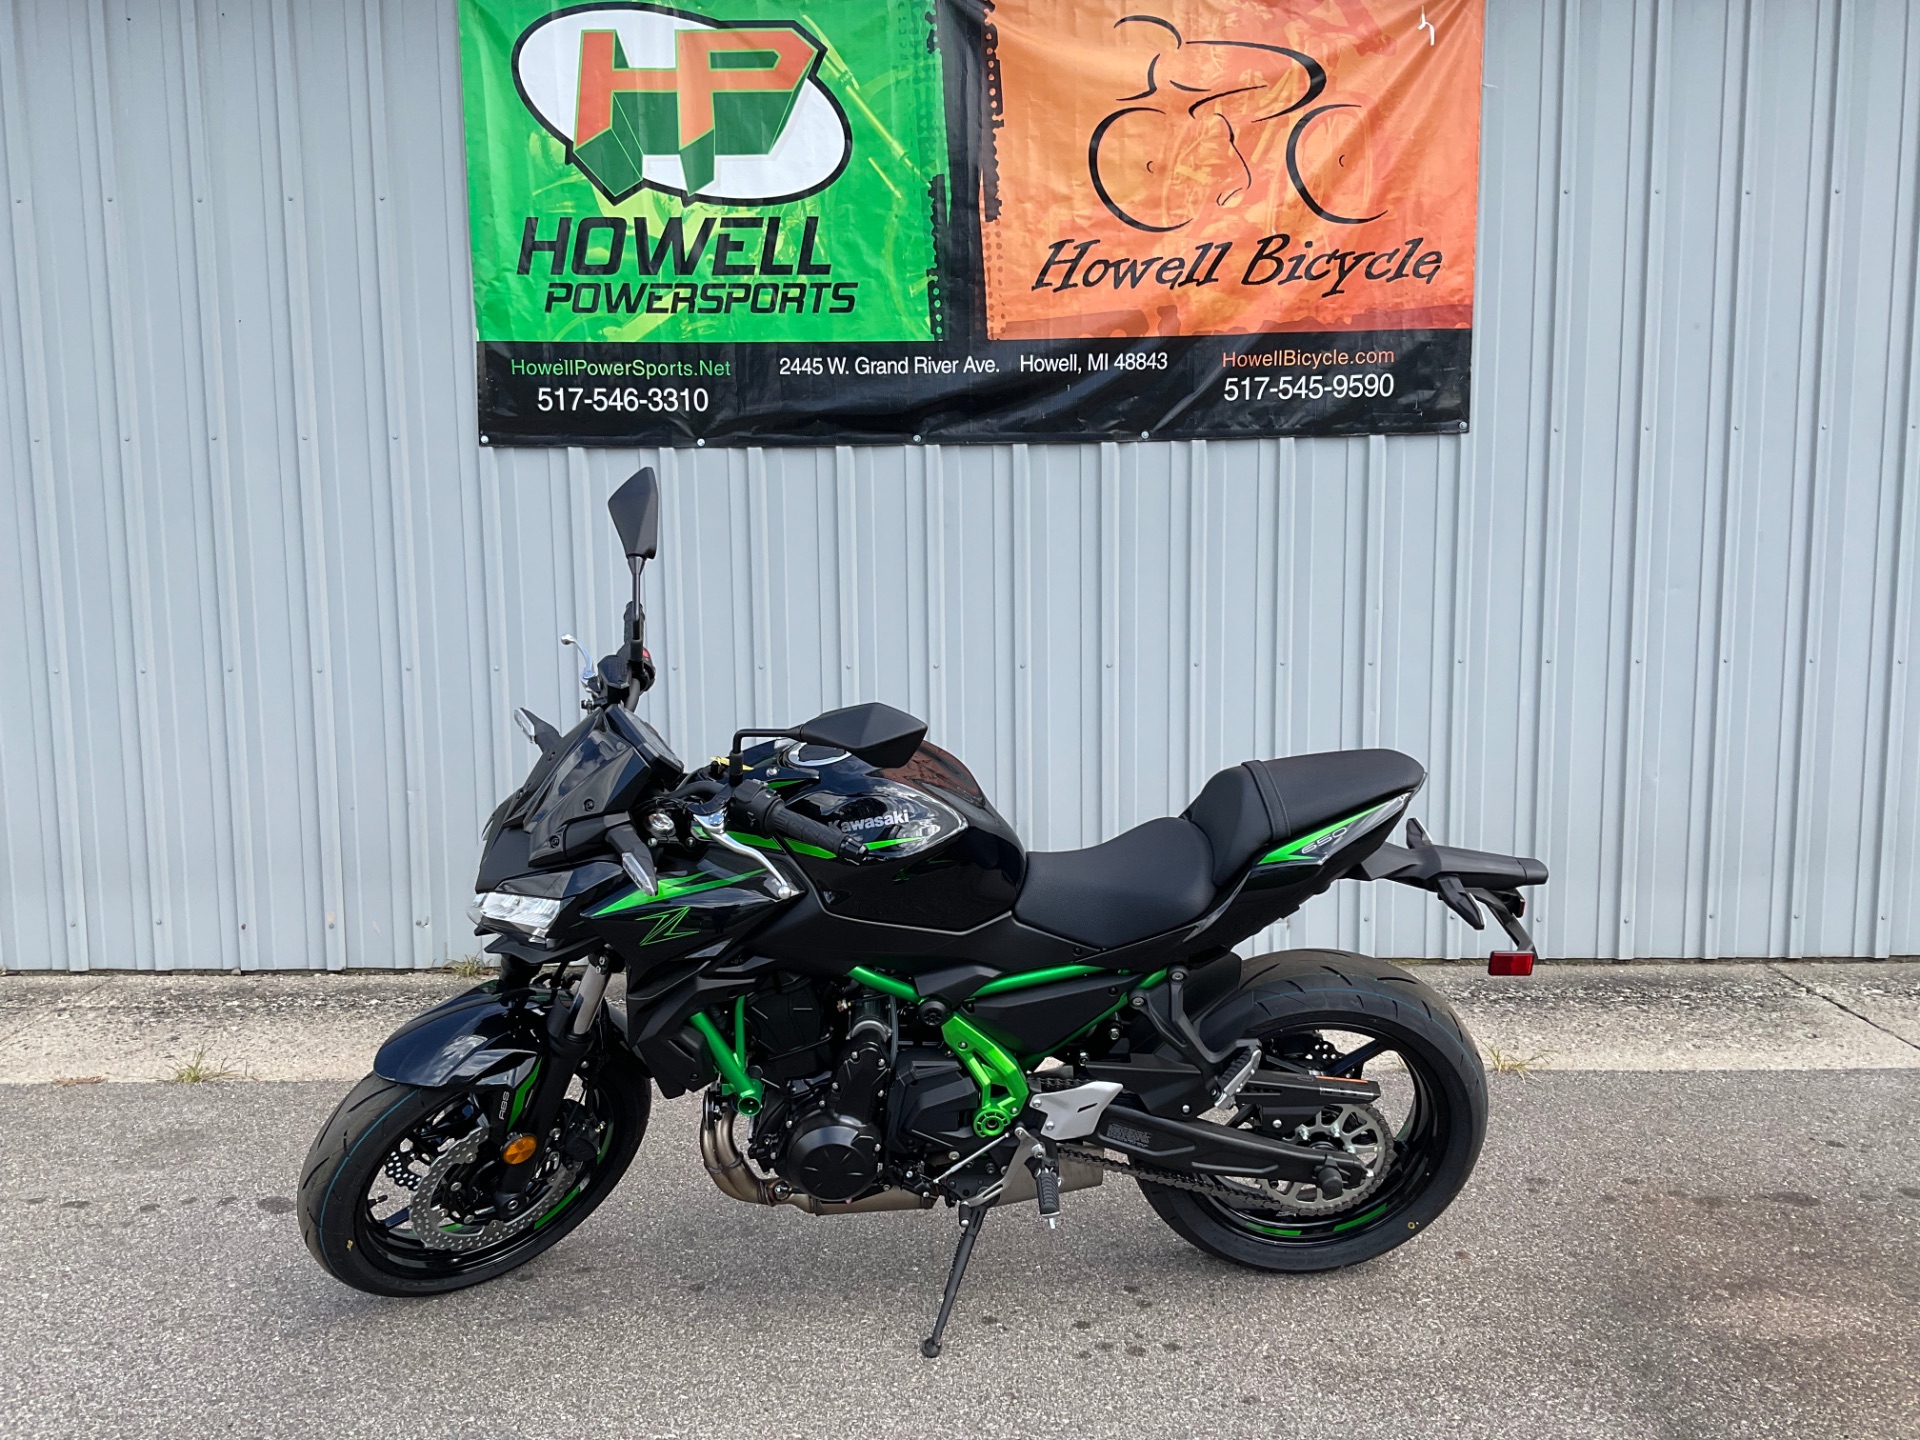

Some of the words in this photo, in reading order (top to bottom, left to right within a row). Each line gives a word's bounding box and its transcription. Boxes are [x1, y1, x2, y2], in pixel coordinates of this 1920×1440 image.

[516, 216, 832, 276] HOWELL
[1031, 239, 1233, 293] Howell
[1241, 233, 1442, 298] Bicycle
[544, 282, 859, 314] POWERSPORTS
[511, 359, 731, 380] HowellPowerSports.Net
[779, 357, 823, 375] 2445
[827, 356, 850, 375] W.
[854, 356, 909, 375] Grand
[914, 355, 959, 374] River
[963, 355, 1000, 373] Ave.
[1020, 353, 1082, 374] Howell,
[1087, 352, 1109, 371] MI
[1113, 351, 1168, 371] 48843
[1222, 349, 1395, 370] HowellBicycle.com
[537, 387, 709, 412] 517-546-3310
[1223, 373, 1395, 402] 517-545-9590
[1301, 827, 1348, 854] 650
